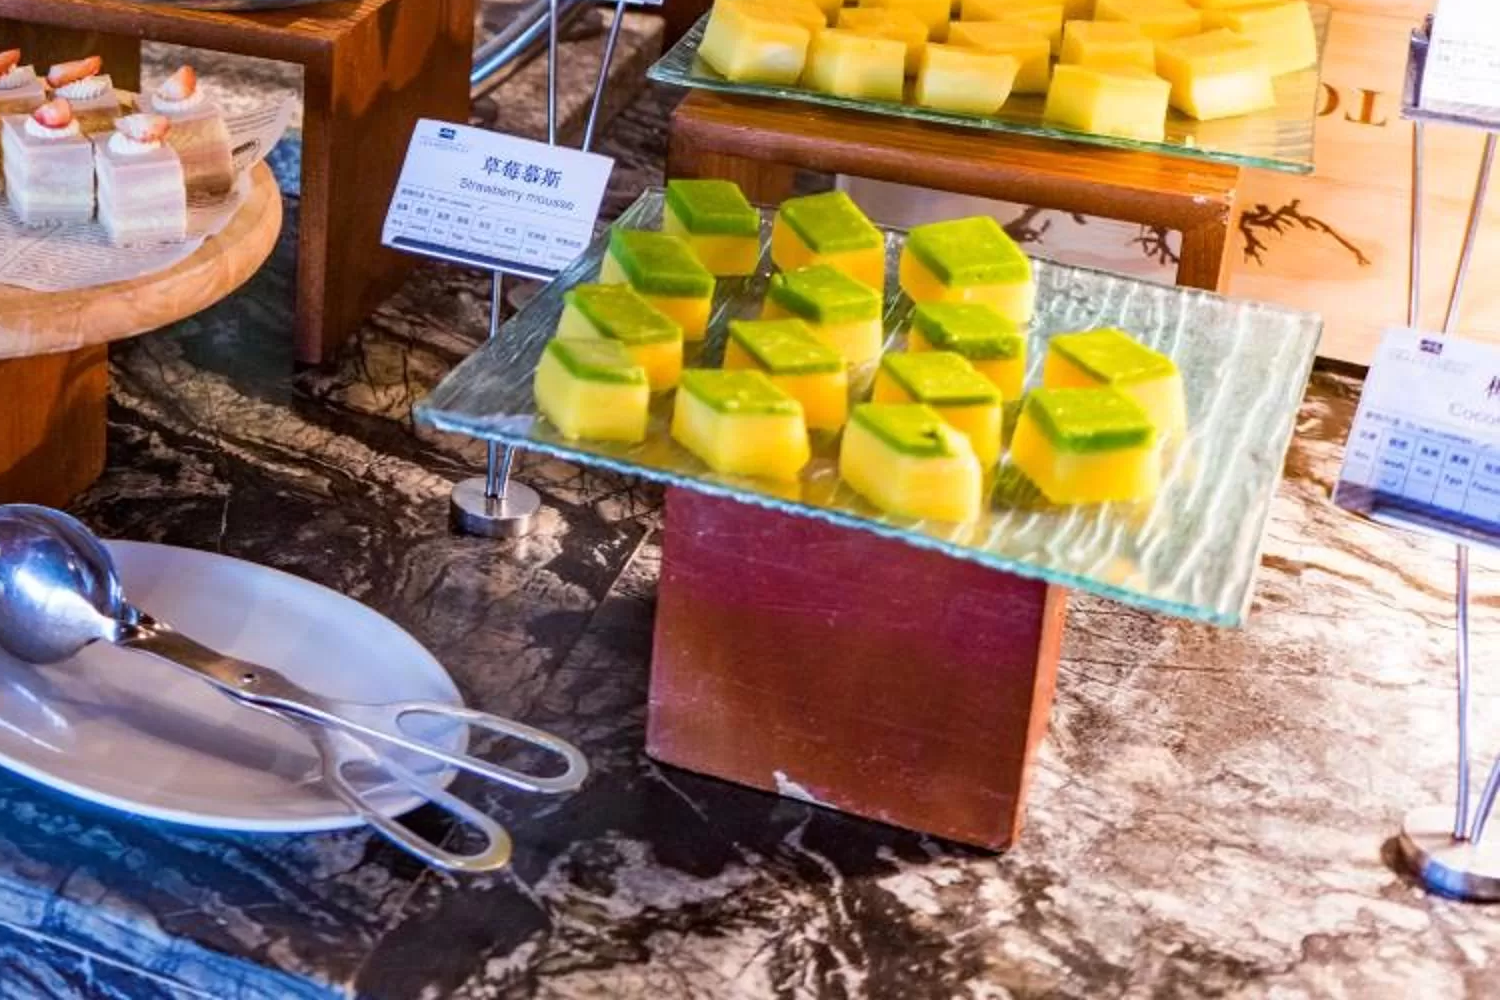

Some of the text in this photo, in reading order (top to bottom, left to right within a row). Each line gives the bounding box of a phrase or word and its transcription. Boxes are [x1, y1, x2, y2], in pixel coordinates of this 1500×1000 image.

[481, 155, 563, 189] 草莓慕斯
[458, 177, 524, 203] Strawberry
[526, 192, 575, 211] mousse
